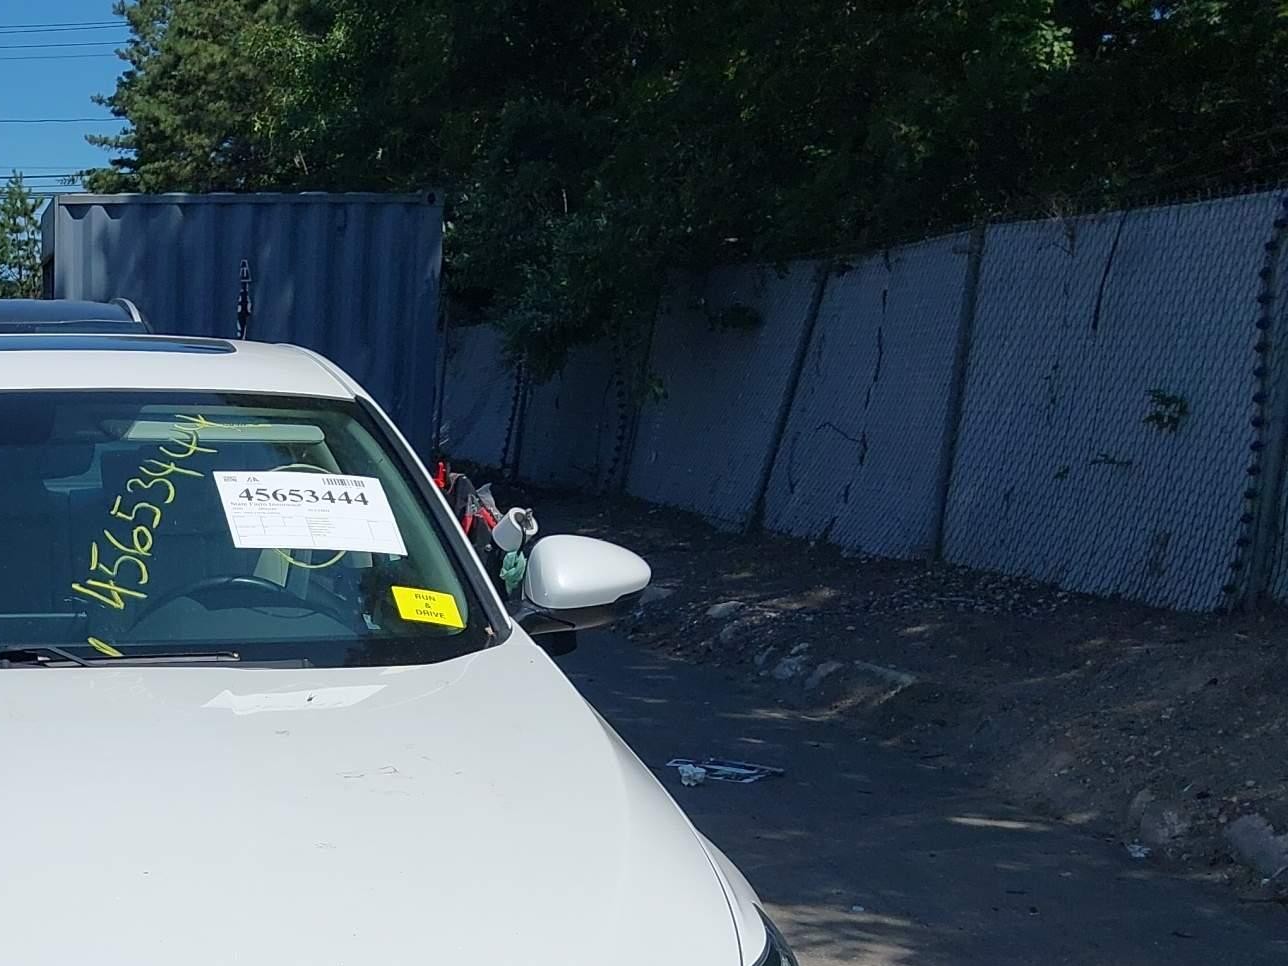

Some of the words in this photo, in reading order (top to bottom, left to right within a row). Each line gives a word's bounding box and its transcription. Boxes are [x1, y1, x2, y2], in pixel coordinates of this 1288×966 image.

[238, 487, 369, 506] 45653444
[71, 414, 218, 610] 45653444
[414, 593, 437, 602] RUN
[415, 608, 446, 620] DRIVE
